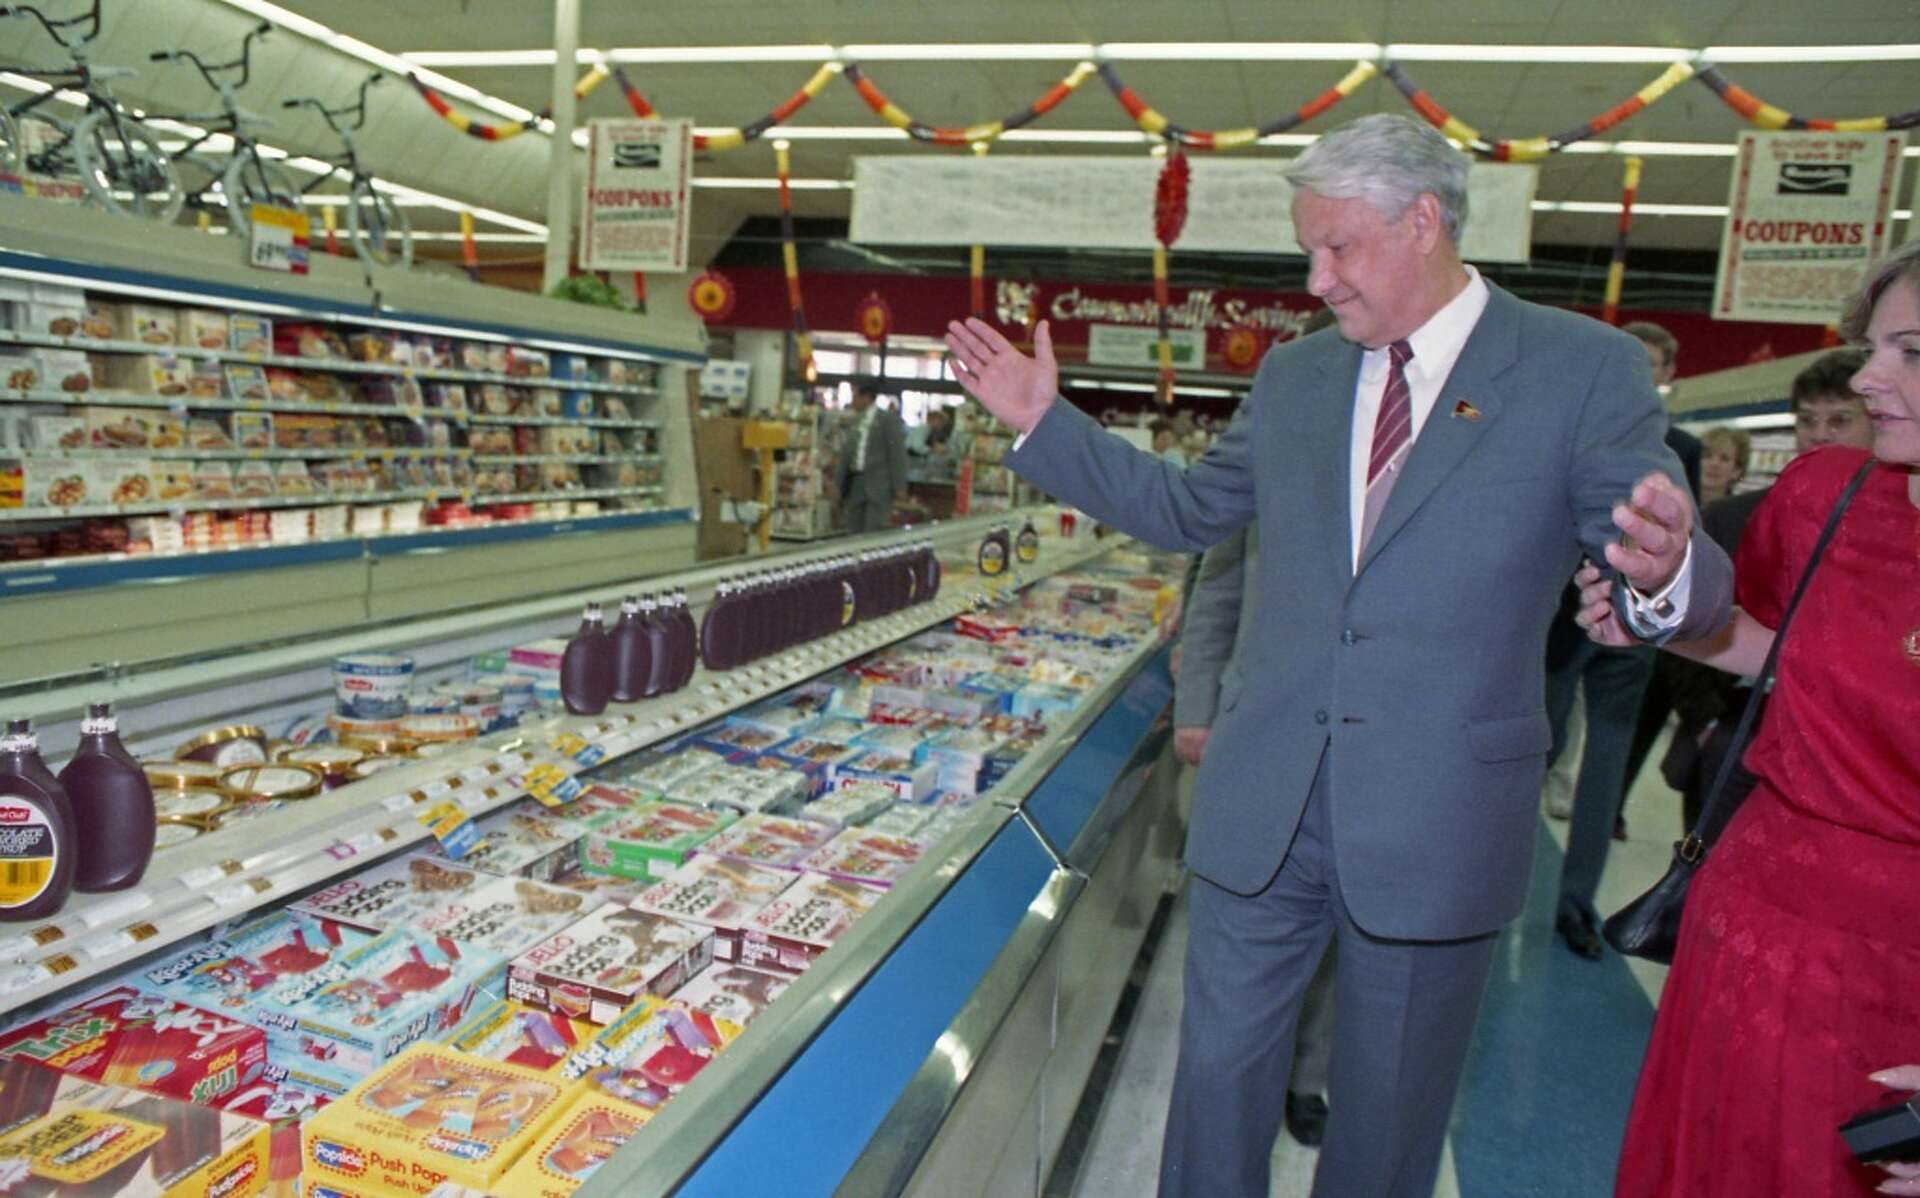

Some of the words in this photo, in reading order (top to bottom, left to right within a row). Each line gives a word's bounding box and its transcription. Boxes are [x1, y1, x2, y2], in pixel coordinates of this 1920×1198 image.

[594, 189, 673, 208] COUPONS
[1744, 219, 1865, 245] COUPONS
[1051, 286, 1216, 331] Commonwalth
[1, 1018, 117, 1060] Trix
[190, 1064, 238, 1104] Trix
[315, 1139, 363, 1169] Popsicle
[370, 1151, 407, 1175] Push
[383, 1174, 410, 1191] Push
